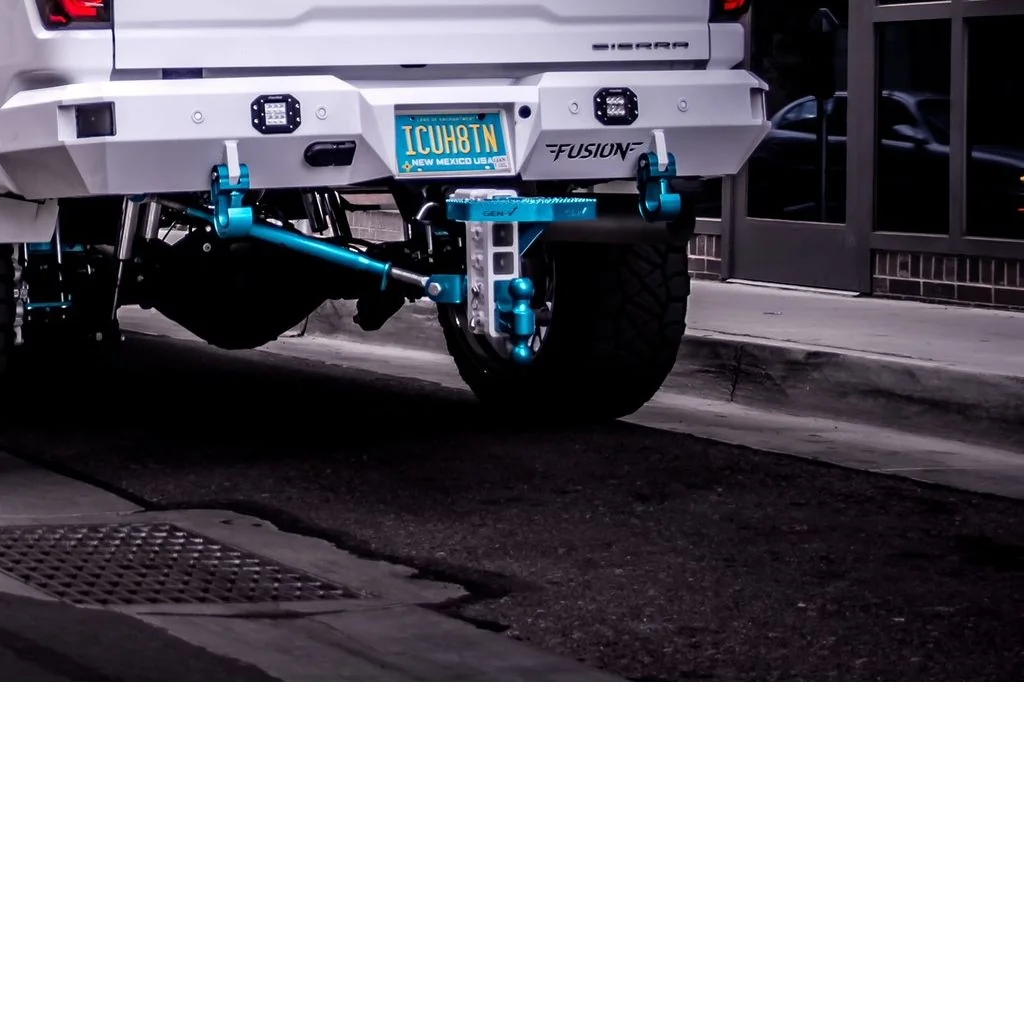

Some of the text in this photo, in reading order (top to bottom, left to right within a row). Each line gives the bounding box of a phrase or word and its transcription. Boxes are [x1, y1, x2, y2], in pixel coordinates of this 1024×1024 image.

[592, 41, 689, 51] SIERRA
[401, 124, 498, 155] ICUH8TN
[545, 142, 644, 162] FUSION
[411, 156, 494, 166] NEW MEXICO USA
